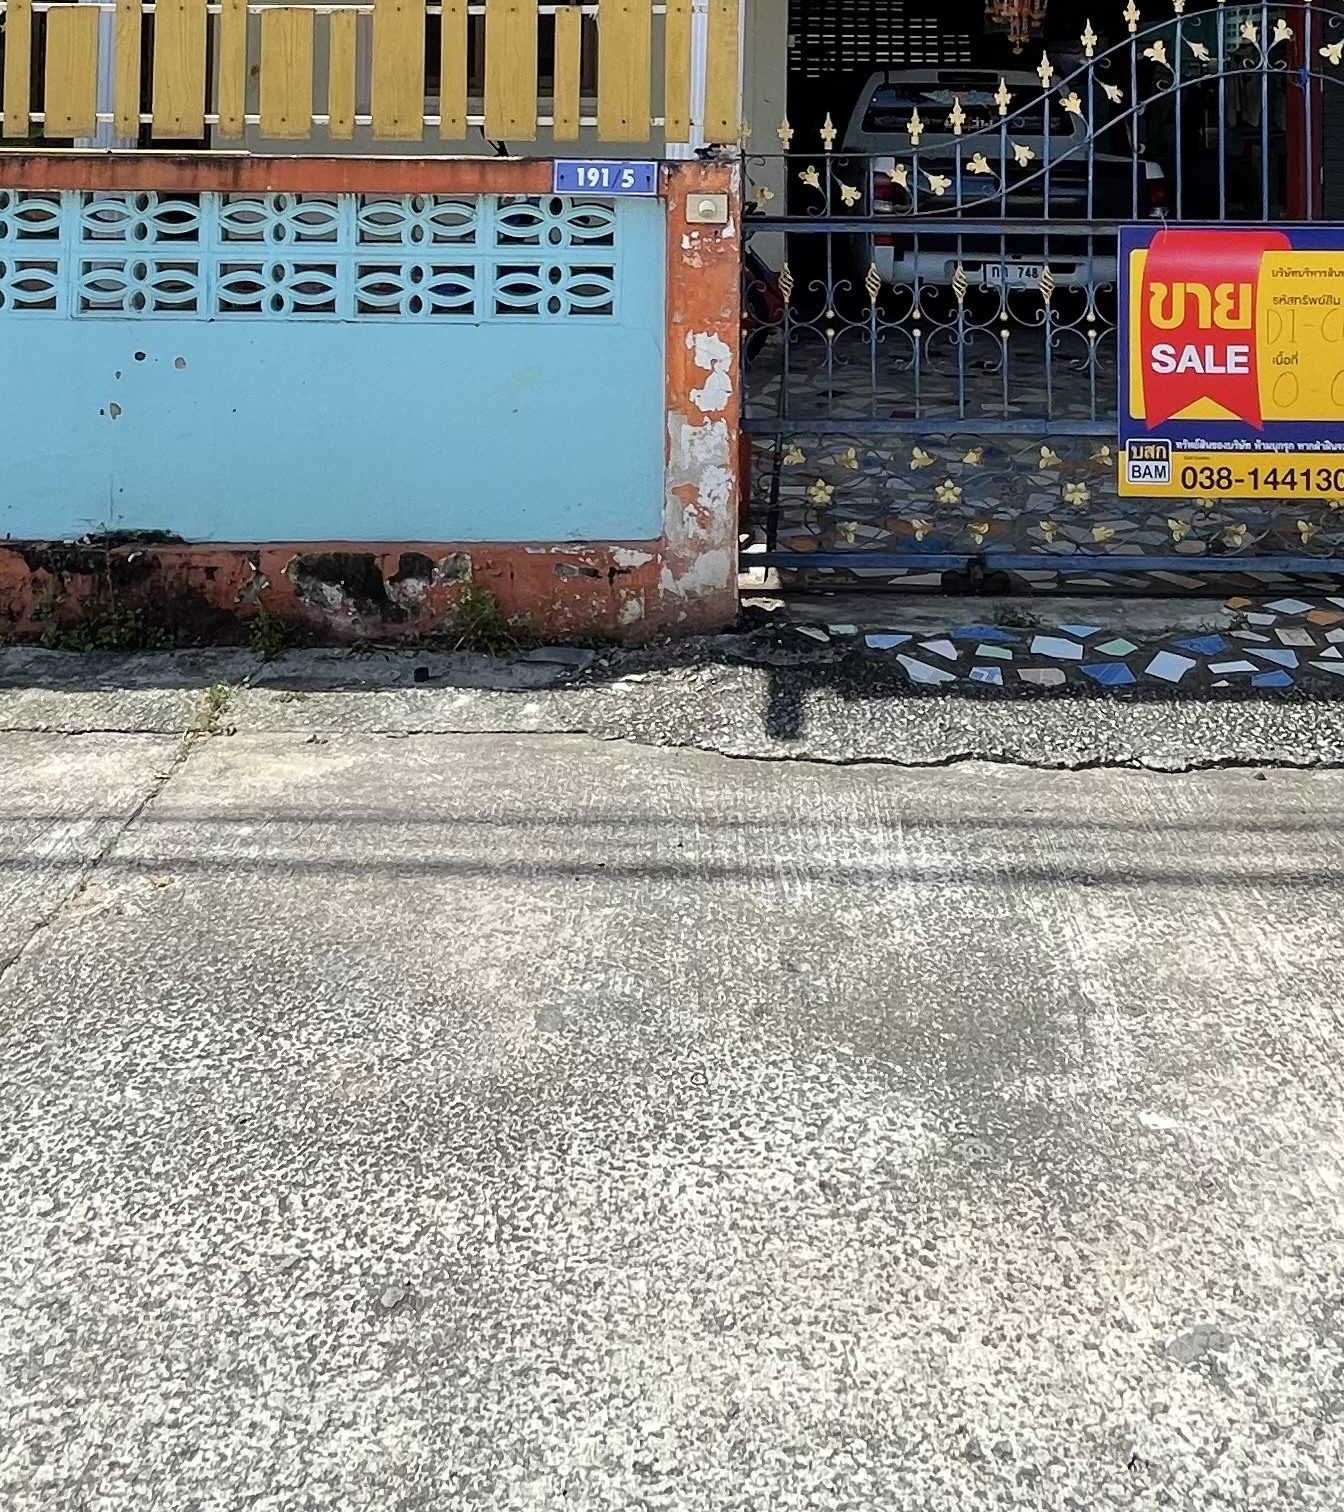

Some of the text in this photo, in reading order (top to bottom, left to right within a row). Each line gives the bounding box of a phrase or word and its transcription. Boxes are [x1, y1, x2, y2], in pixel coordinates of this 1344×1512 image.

[576, 167, 636, 189] 191/5
[1017, 266, 1039, 278] 748
[1149, 282, 1253, 330] ขาย
[1272, 294, 1341, 306] รหัสทรัพย์สิน
[1151, 344, 1250, 374] SALE
[1272, 351, 1299, 366] เนื้อที่
[1131, 444, 1167, 460] บสก
[1131, 464, 1167, 479] BAM
